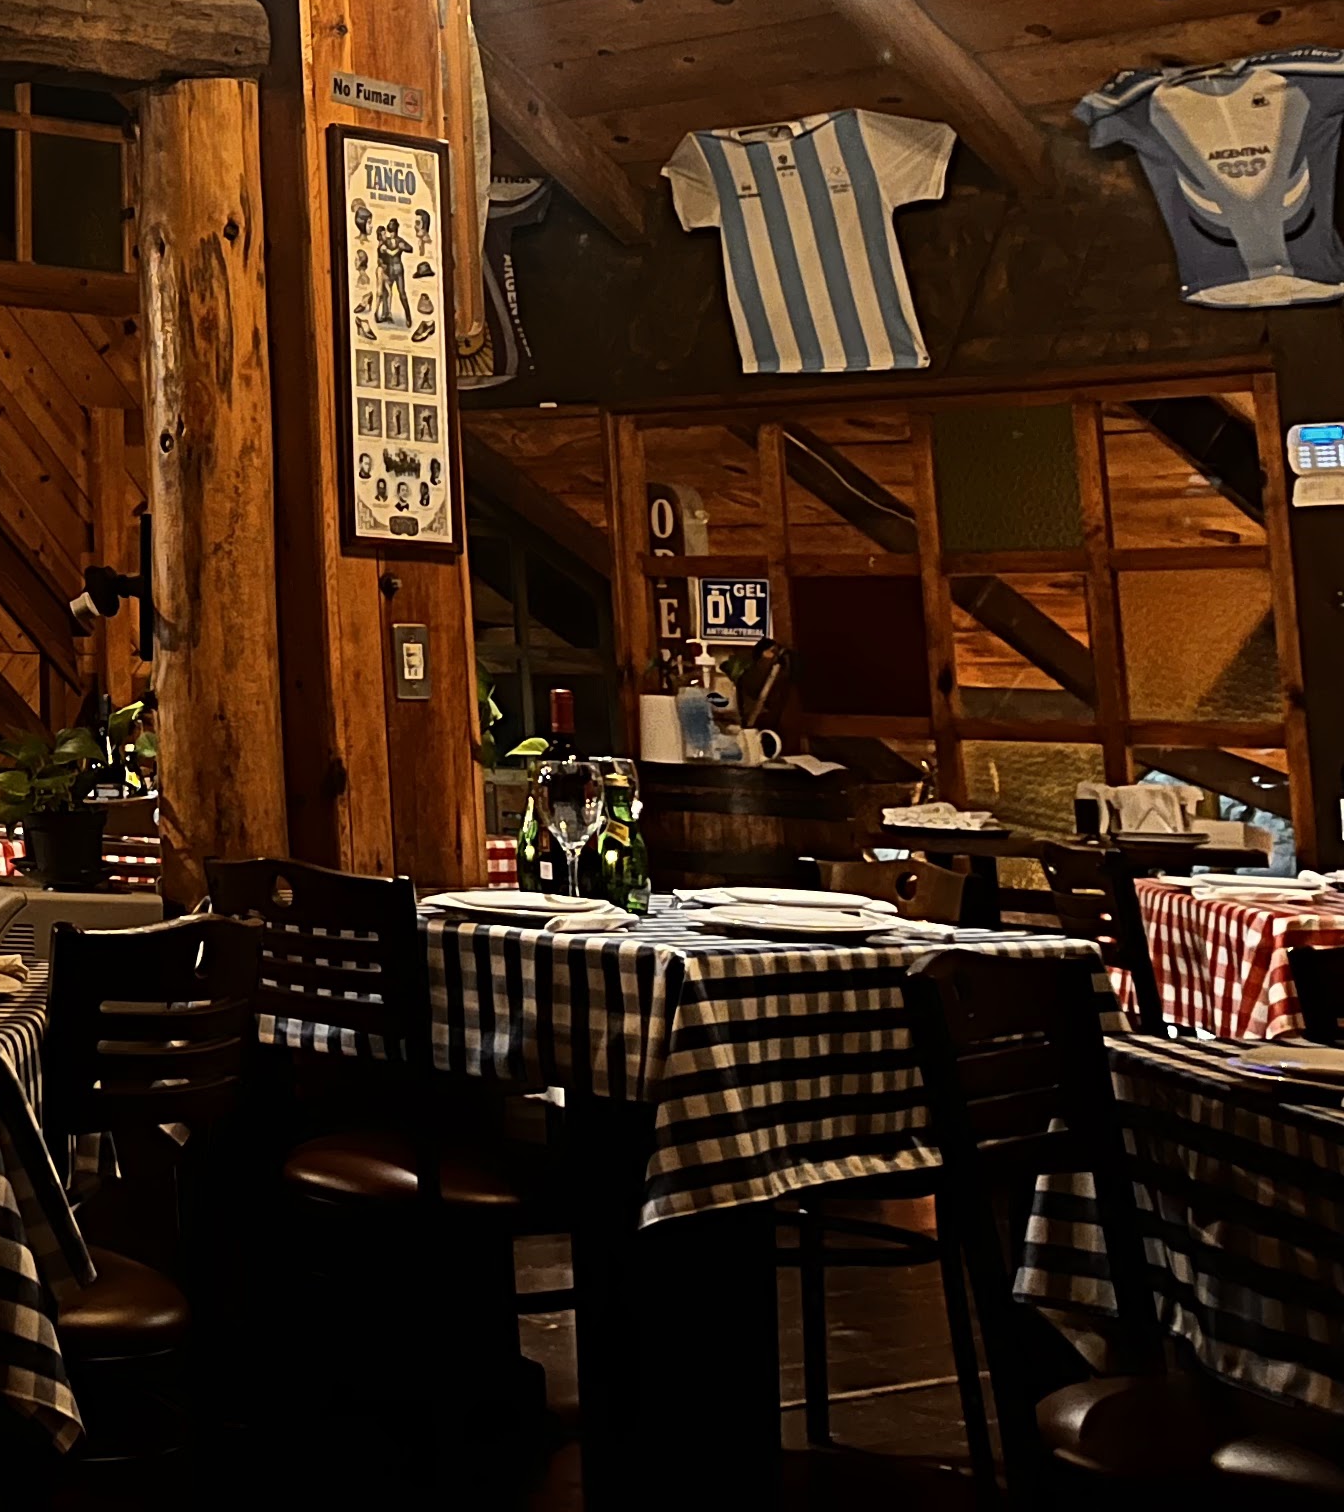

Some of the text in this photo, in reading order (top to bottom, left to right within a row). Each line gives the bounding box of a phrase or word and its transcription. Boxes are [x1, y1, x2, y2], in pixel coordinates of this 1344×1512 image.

[333, 77, 397, 107] No Fumar
[1208, 145, 1271, 161] ARGENTINA
[364, 163, 417, 196] TANGO
[733, 583, 766, 598] GEL
[706, 627, 765, 637] ANTIBACTERIAL
